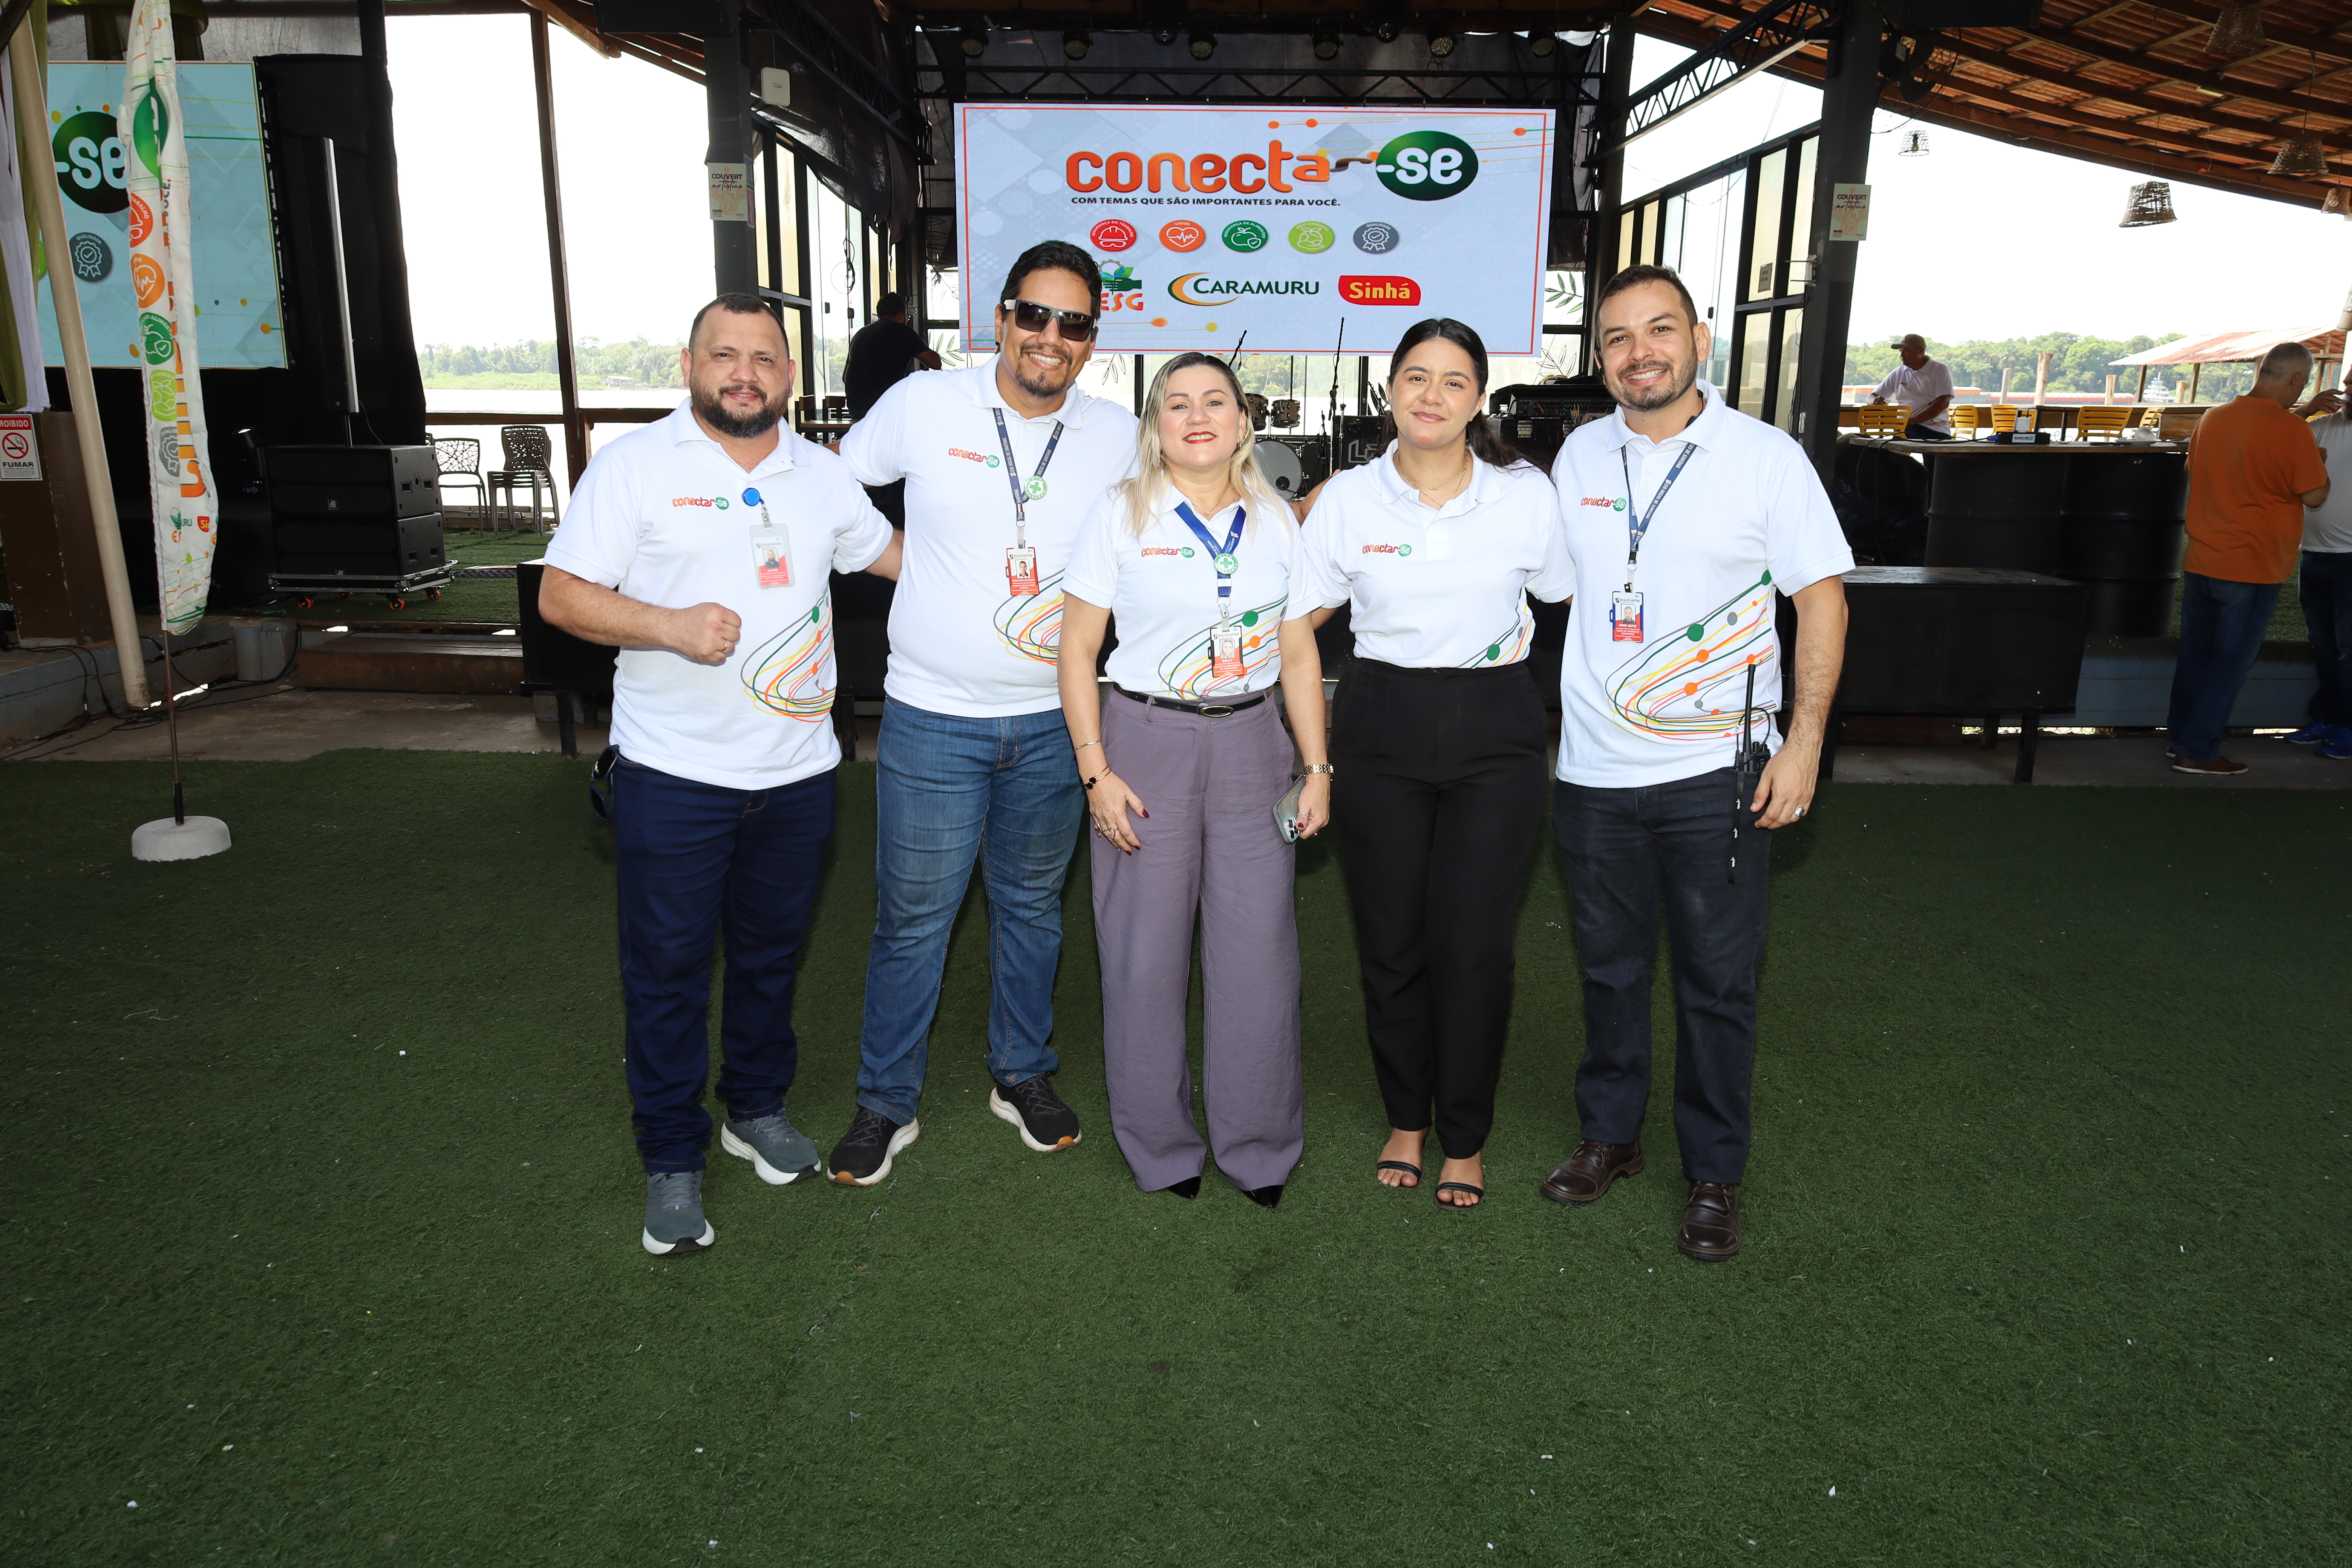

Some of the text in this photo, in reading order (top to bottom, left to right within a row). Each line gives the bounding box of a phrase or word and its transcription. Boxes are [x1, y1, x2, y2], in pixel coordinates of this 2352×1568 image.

[1167, 196, 1190, 205] SÃO
[1307, 198, 1341, 207] VOCÊ.
[1091, 220, 1110, 236] SEGURANÇA
[1119, 222, 1134, 237] TRABALHO
[1223, 222, 1242, 237] SEGURANÇA
[1250, 222, 1266, 239] ALIMENTOS
[1308, 222, 1329, 231] AMBIENTE
[76, 234, 103, 245] QUALIDADE
[1193, 278, 1319, 294] CARAMURU
[1349, 282, 1410, 299] Sinhá
[1100, 292, 1144, 312] ESG
[1043, 449, 1052, 462] SANTANA
[1675, 453, 1687, 469] SANTANA
[1656, 489, 1665, 500] DOCAS
[1645, 504, 1656, 519] SANTANA
